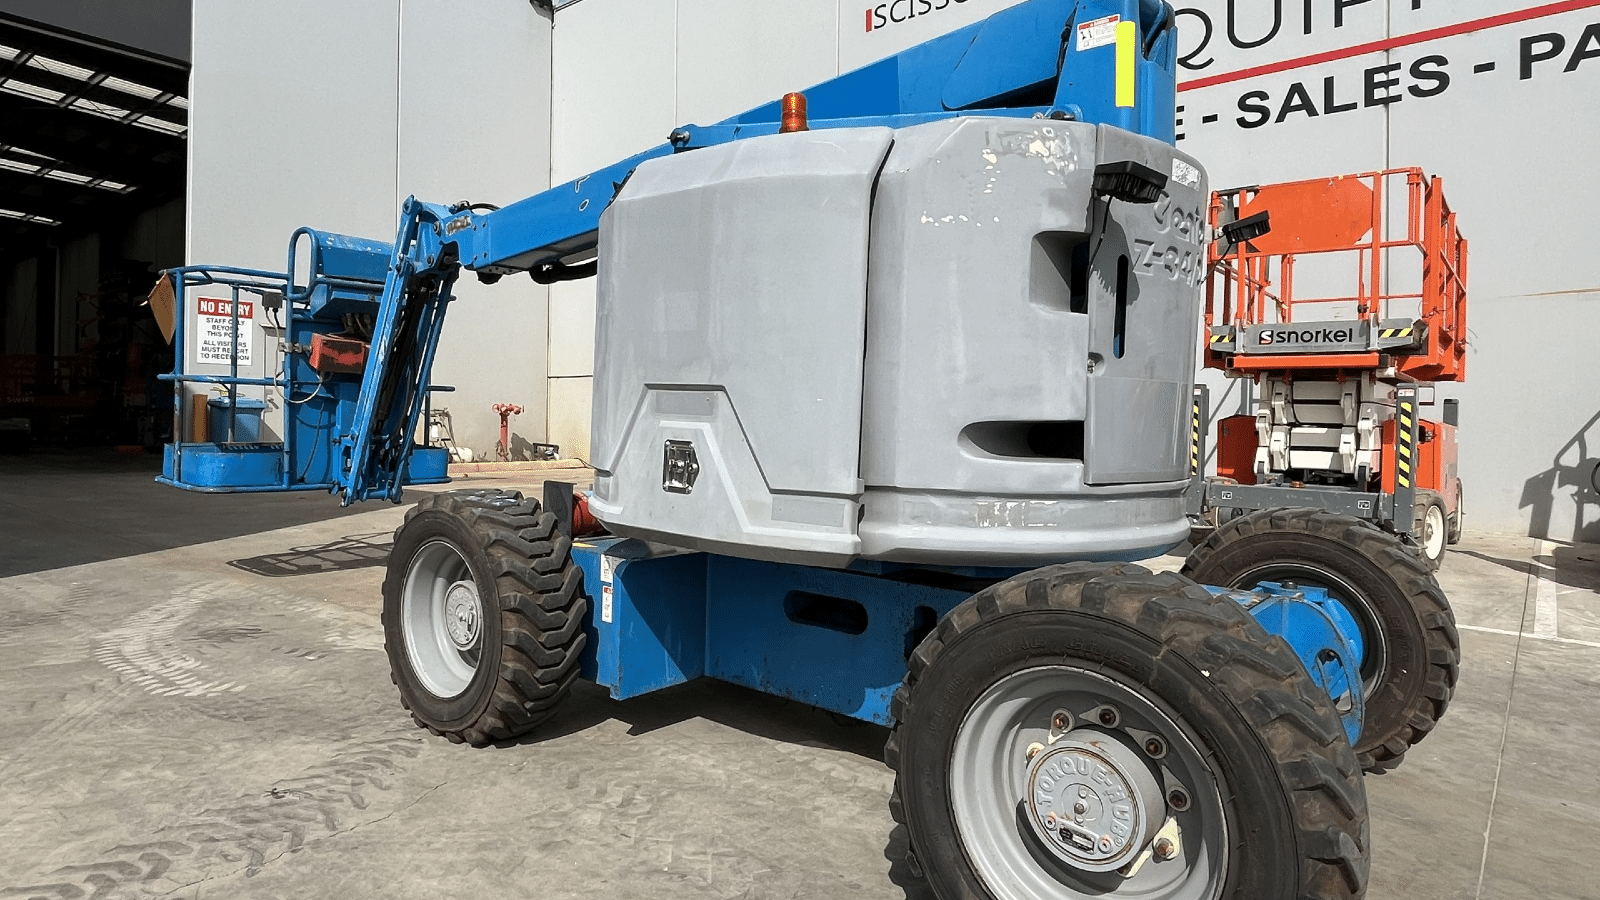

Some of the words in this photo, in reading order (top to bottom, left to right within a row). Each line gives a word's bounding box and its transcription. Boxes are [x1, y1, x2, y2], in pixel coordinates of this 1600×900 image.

[1236, 55, 1450, 129] SALES
[200, 300, 215, 313] NO
[218, 302, 251, 316] ENRY
[1276, 328, 1353, 343] snorkel
